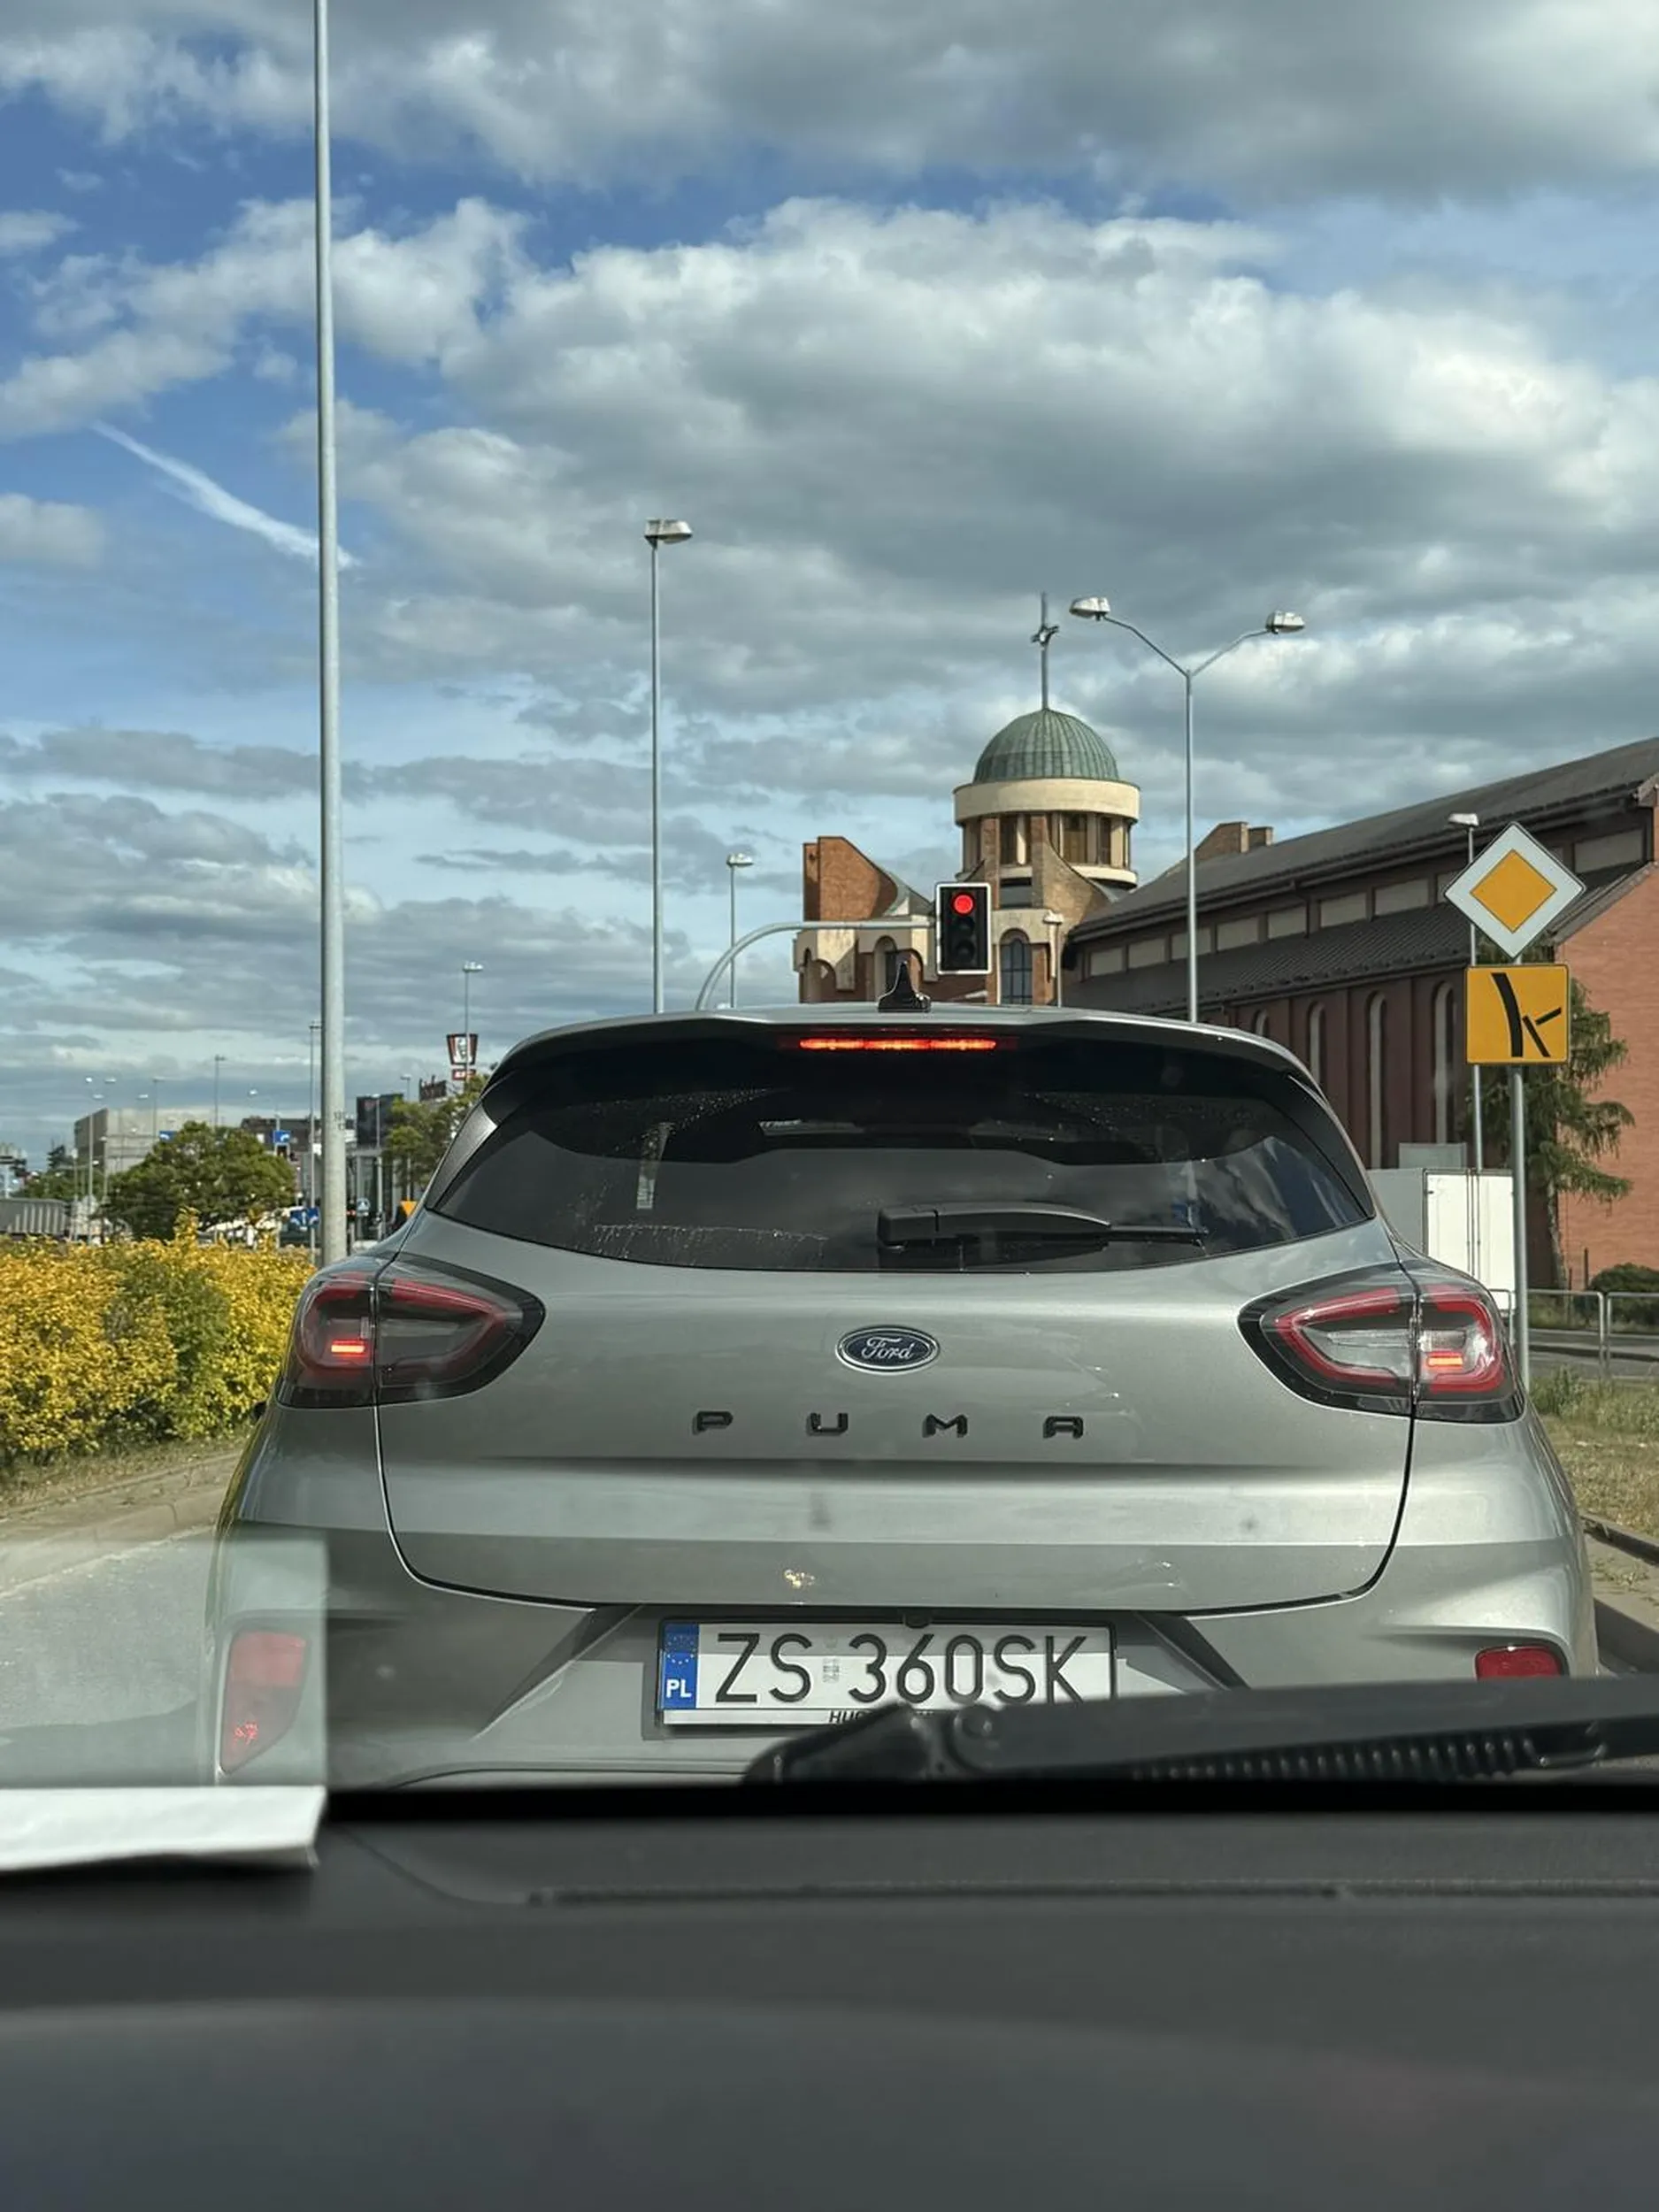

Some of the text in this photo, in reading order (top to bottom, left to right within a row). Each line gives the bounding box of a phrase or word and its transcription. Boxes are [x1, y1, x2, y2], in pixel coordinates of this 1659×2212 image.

[861, 1336, 915, 1359] Ford
[695, 1410, 1084, 1439] PUMA
[715, 1632, 1087, 1706] ZS 360SK
[665, 1678, 693, 1698] PL
